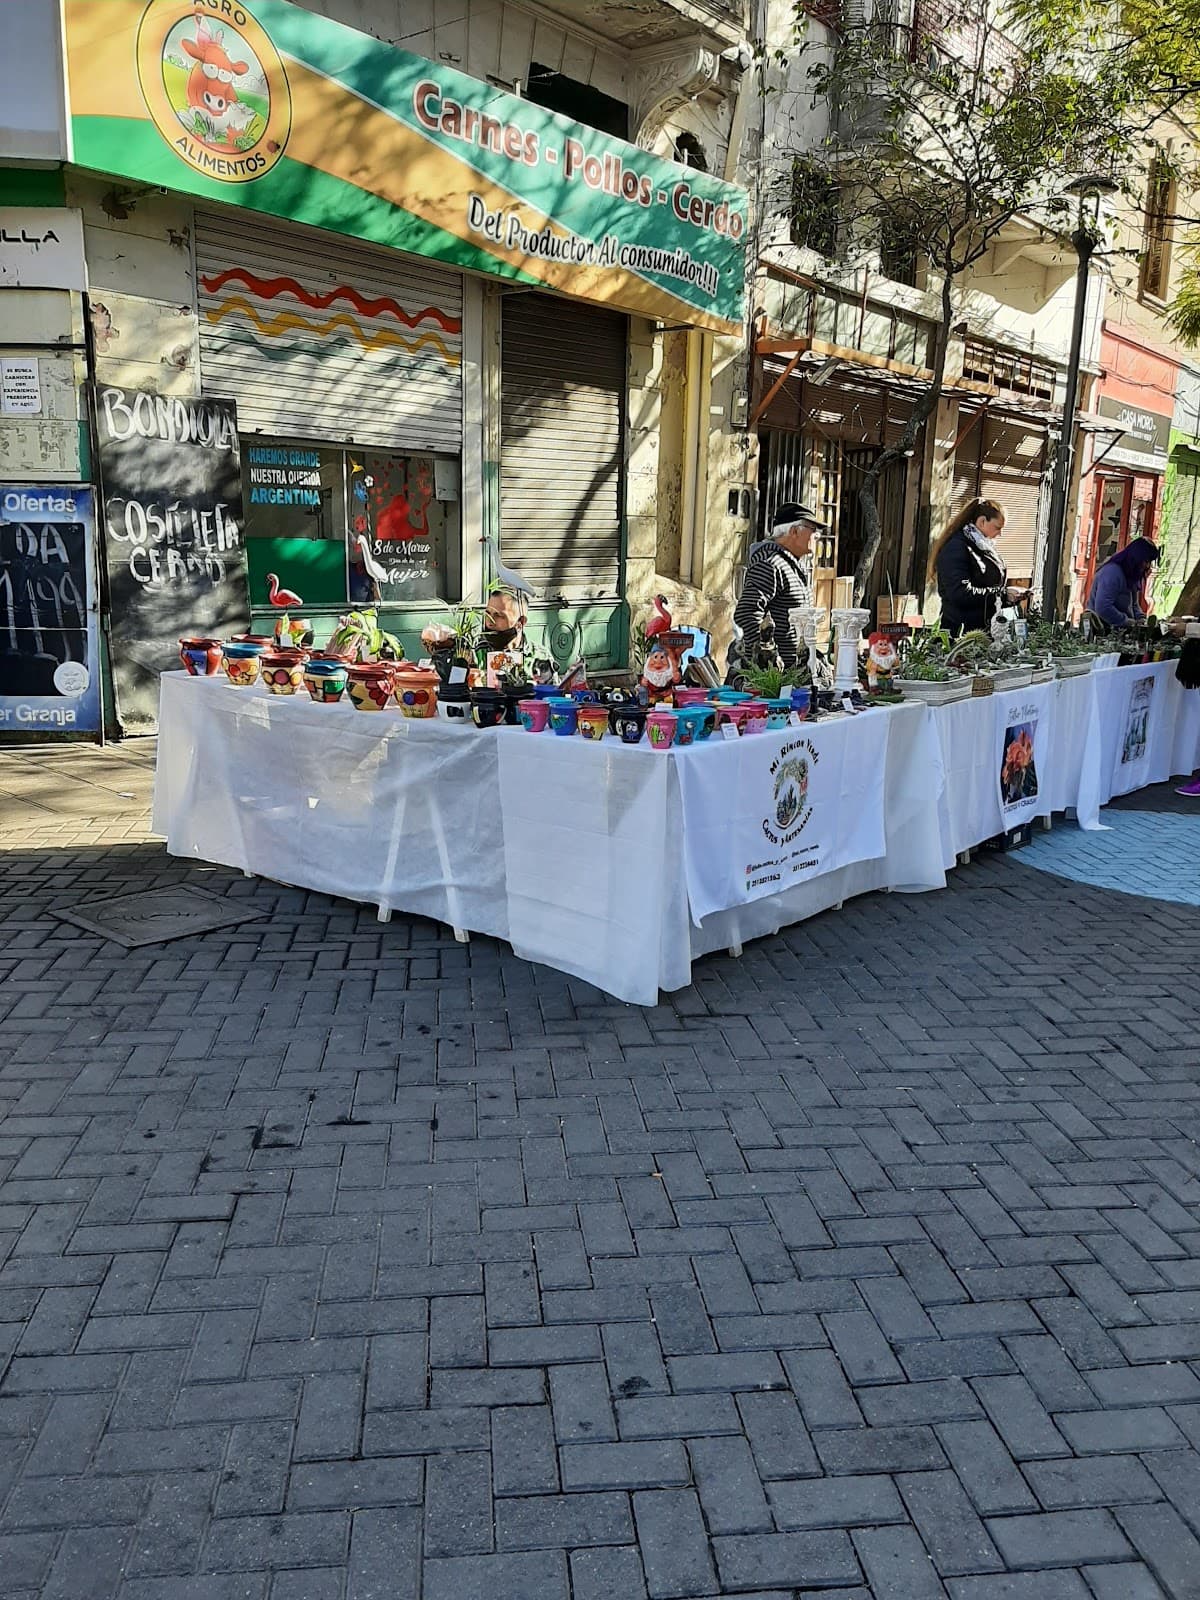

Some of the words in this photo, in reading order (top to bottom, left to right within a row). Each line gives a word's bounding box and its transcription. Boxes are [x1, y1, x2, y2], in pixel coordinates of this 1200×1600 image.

[176, 136, 266, 176] ALIMENTOS
[414, 80, 540, 167] Carnes
[565, 137, 653, 208] Pollos
[672, 182, 743, 240] Cerdo
[0, 229, 60, 243] LLA
[468, 195, 503, 240] Del
[506, 214, 595, 265] Productor
[598, 235, 617, 268] Al
[619, 243, 720, 297] consumidor!!!
[1121, 408, 1137, 428] CASA
[1136, 414, 1153, 432] MORO
[249, 447, 288, 466] HAREMOS
[289, 450, 321, 468] GRANDE
[250, 468, 287, 485] NUESTRA
[4, 493, 77, 512] Ofertas
[250, 488, 321, 505] ARGENTINA
[373, 539, 383, 556] 8
[383, 541, 394, 554] de
[396, 540, 431, 556] Marzo
[16, 704, 76, 726] Granja
